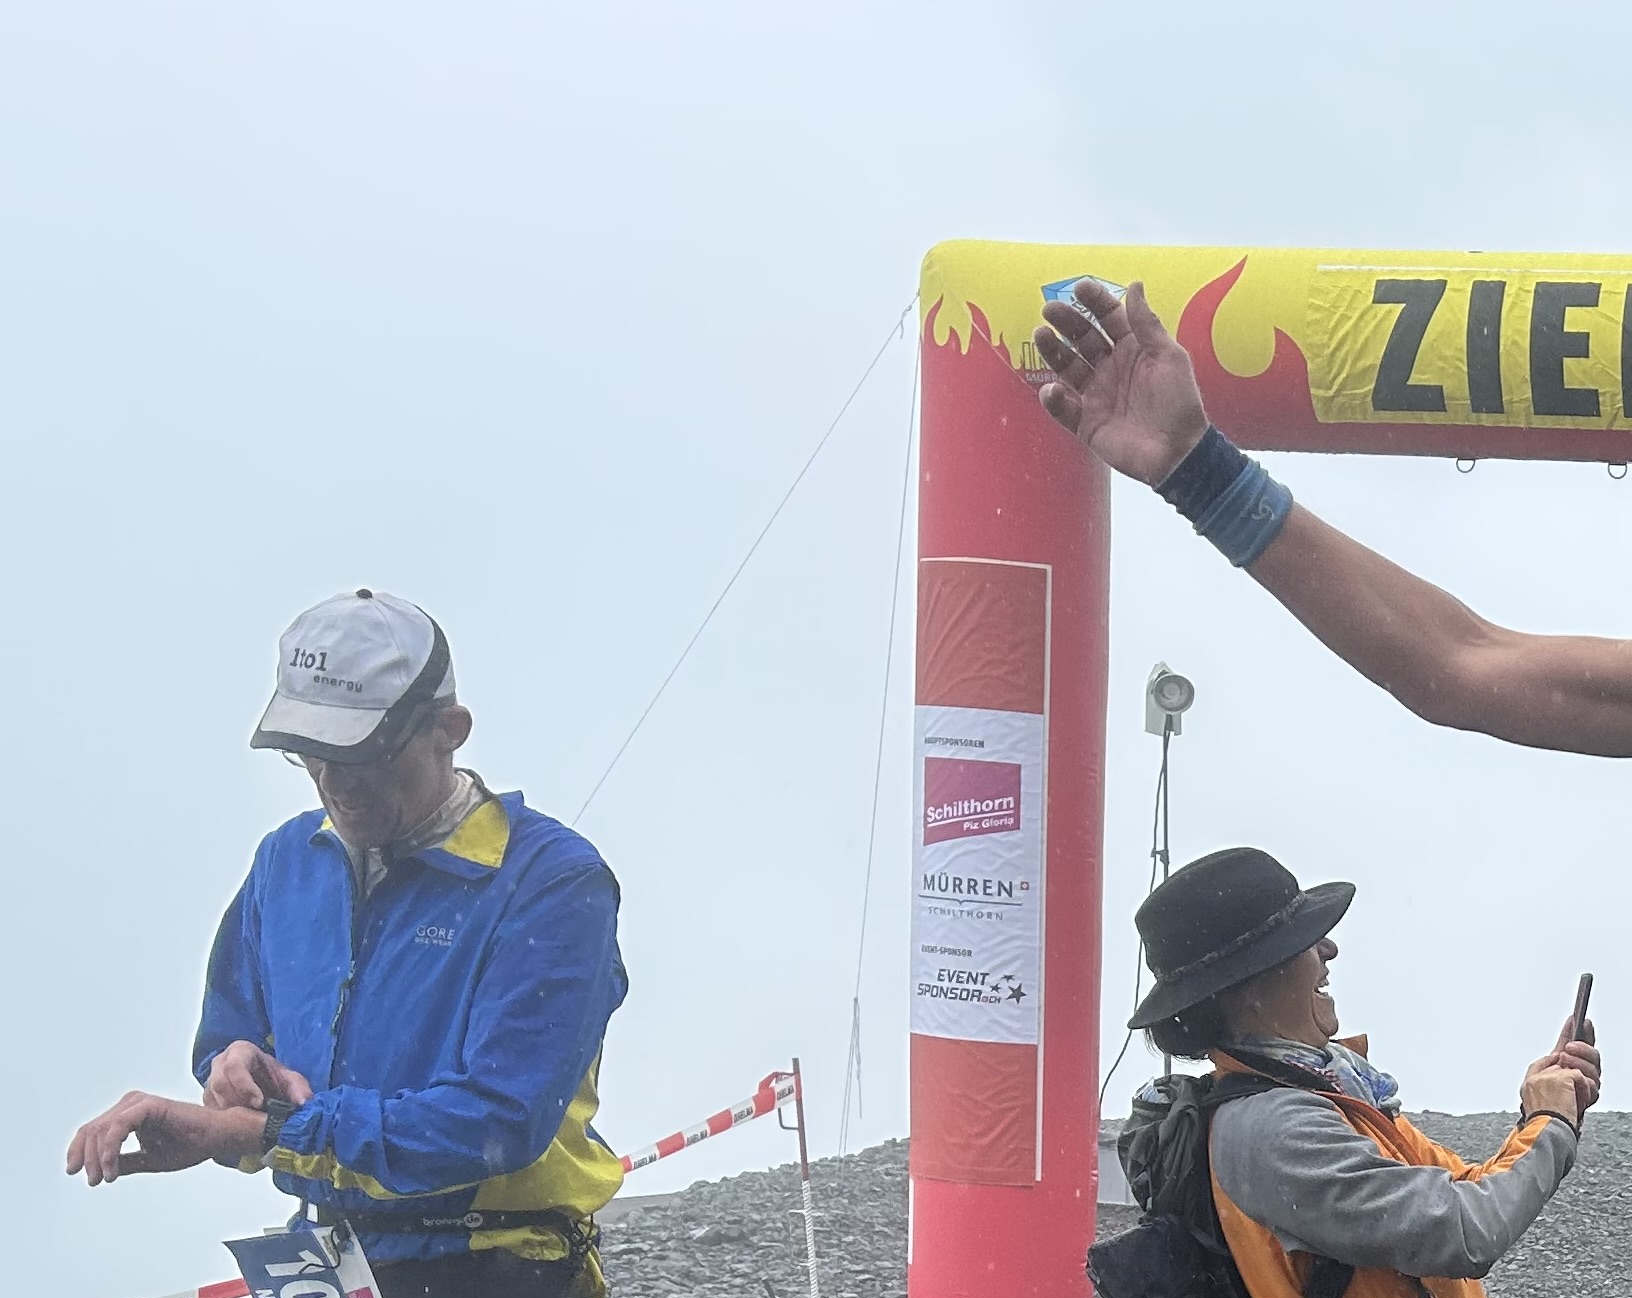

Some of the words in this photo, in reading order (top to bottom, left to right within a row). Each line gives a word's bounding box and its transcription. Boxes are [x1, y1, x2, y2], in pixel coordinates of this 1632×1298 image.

[313, 675, 363, 693] energy
[926, 796, 1015, 823] Schilthorn
[963, 820, 980, 831] Piz
[981, 816, 1015, 829] Gloria
[923, 872, 1013, 898] MÜRREN
[928, 906, 1004, 920] SCHILTHORN
[416, 925, 455, 940] GORE
[937, 968, 990, 986] EVENT
